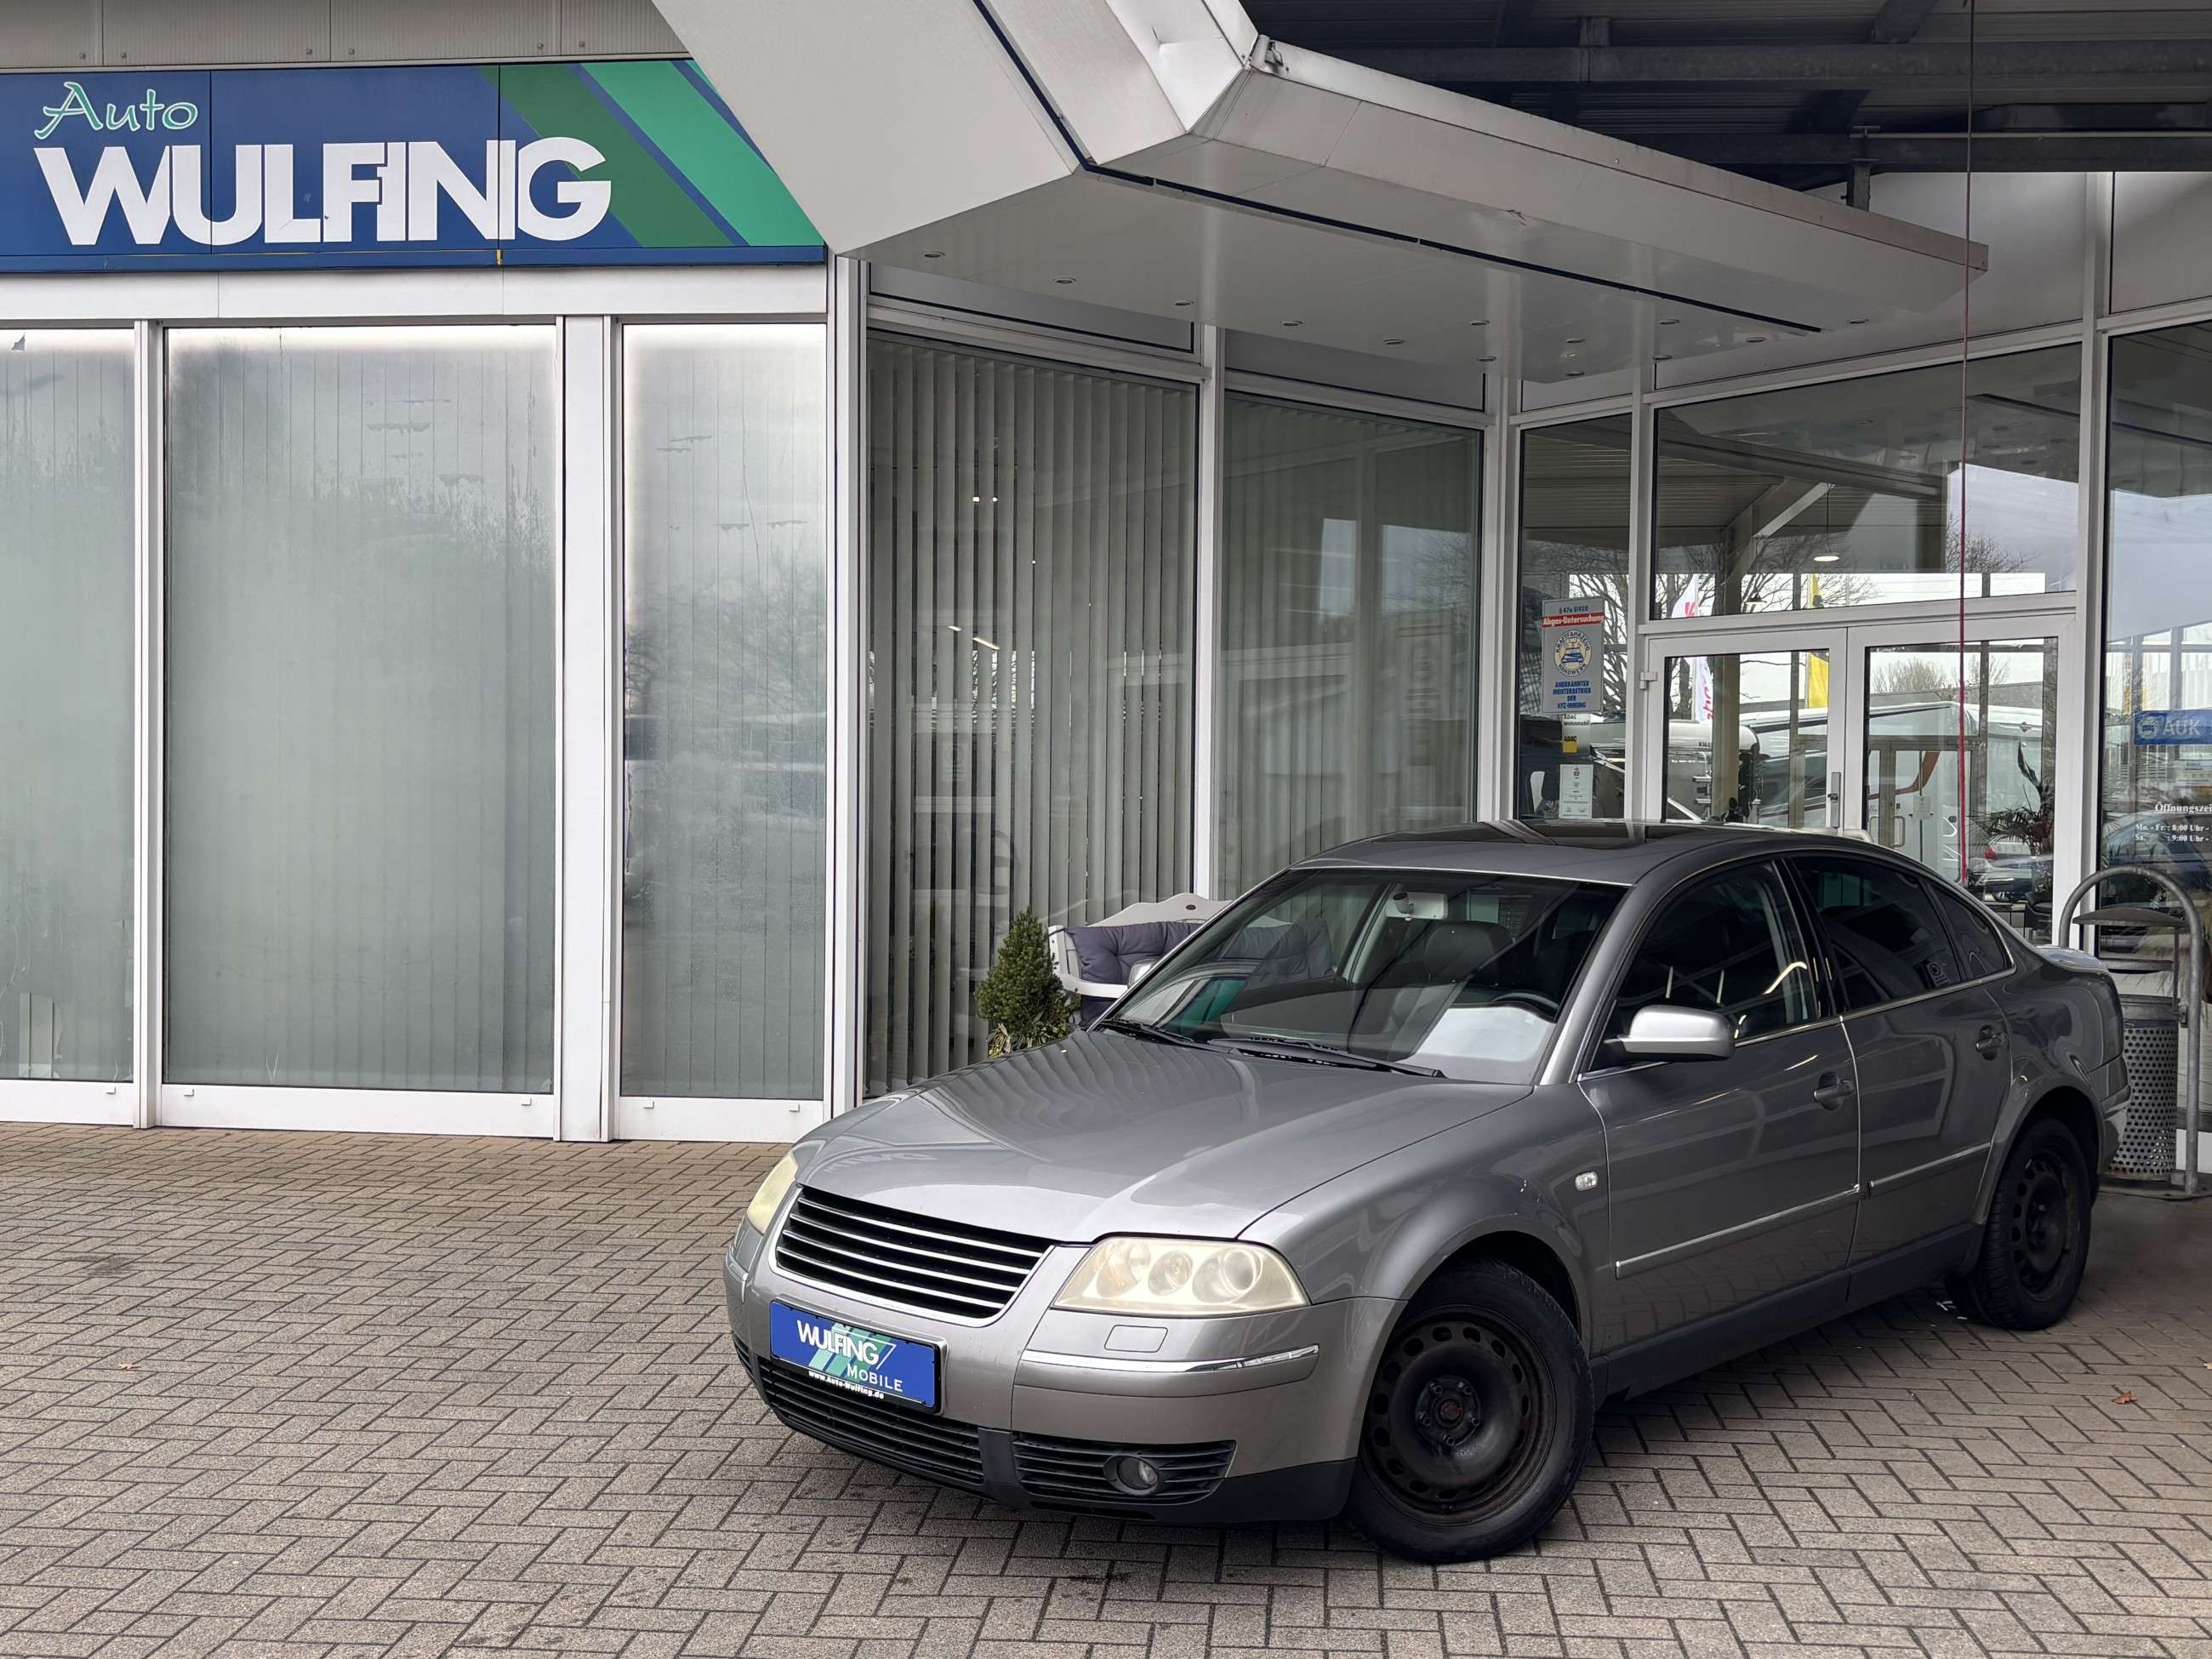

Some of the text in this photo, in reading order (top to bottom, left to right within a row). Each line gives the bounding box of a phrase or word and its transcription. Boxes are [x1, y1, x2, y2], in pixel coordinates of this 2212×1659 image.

[33, 81, 199, 140] Auto
[33, 136, 612, 247] WULFING
[1542, 614, 1605, 627] Abgas-Untersuchung
[796, 1320, 880, 1365] WULFING
[847, 1363, 904, 1393] MOBILE
